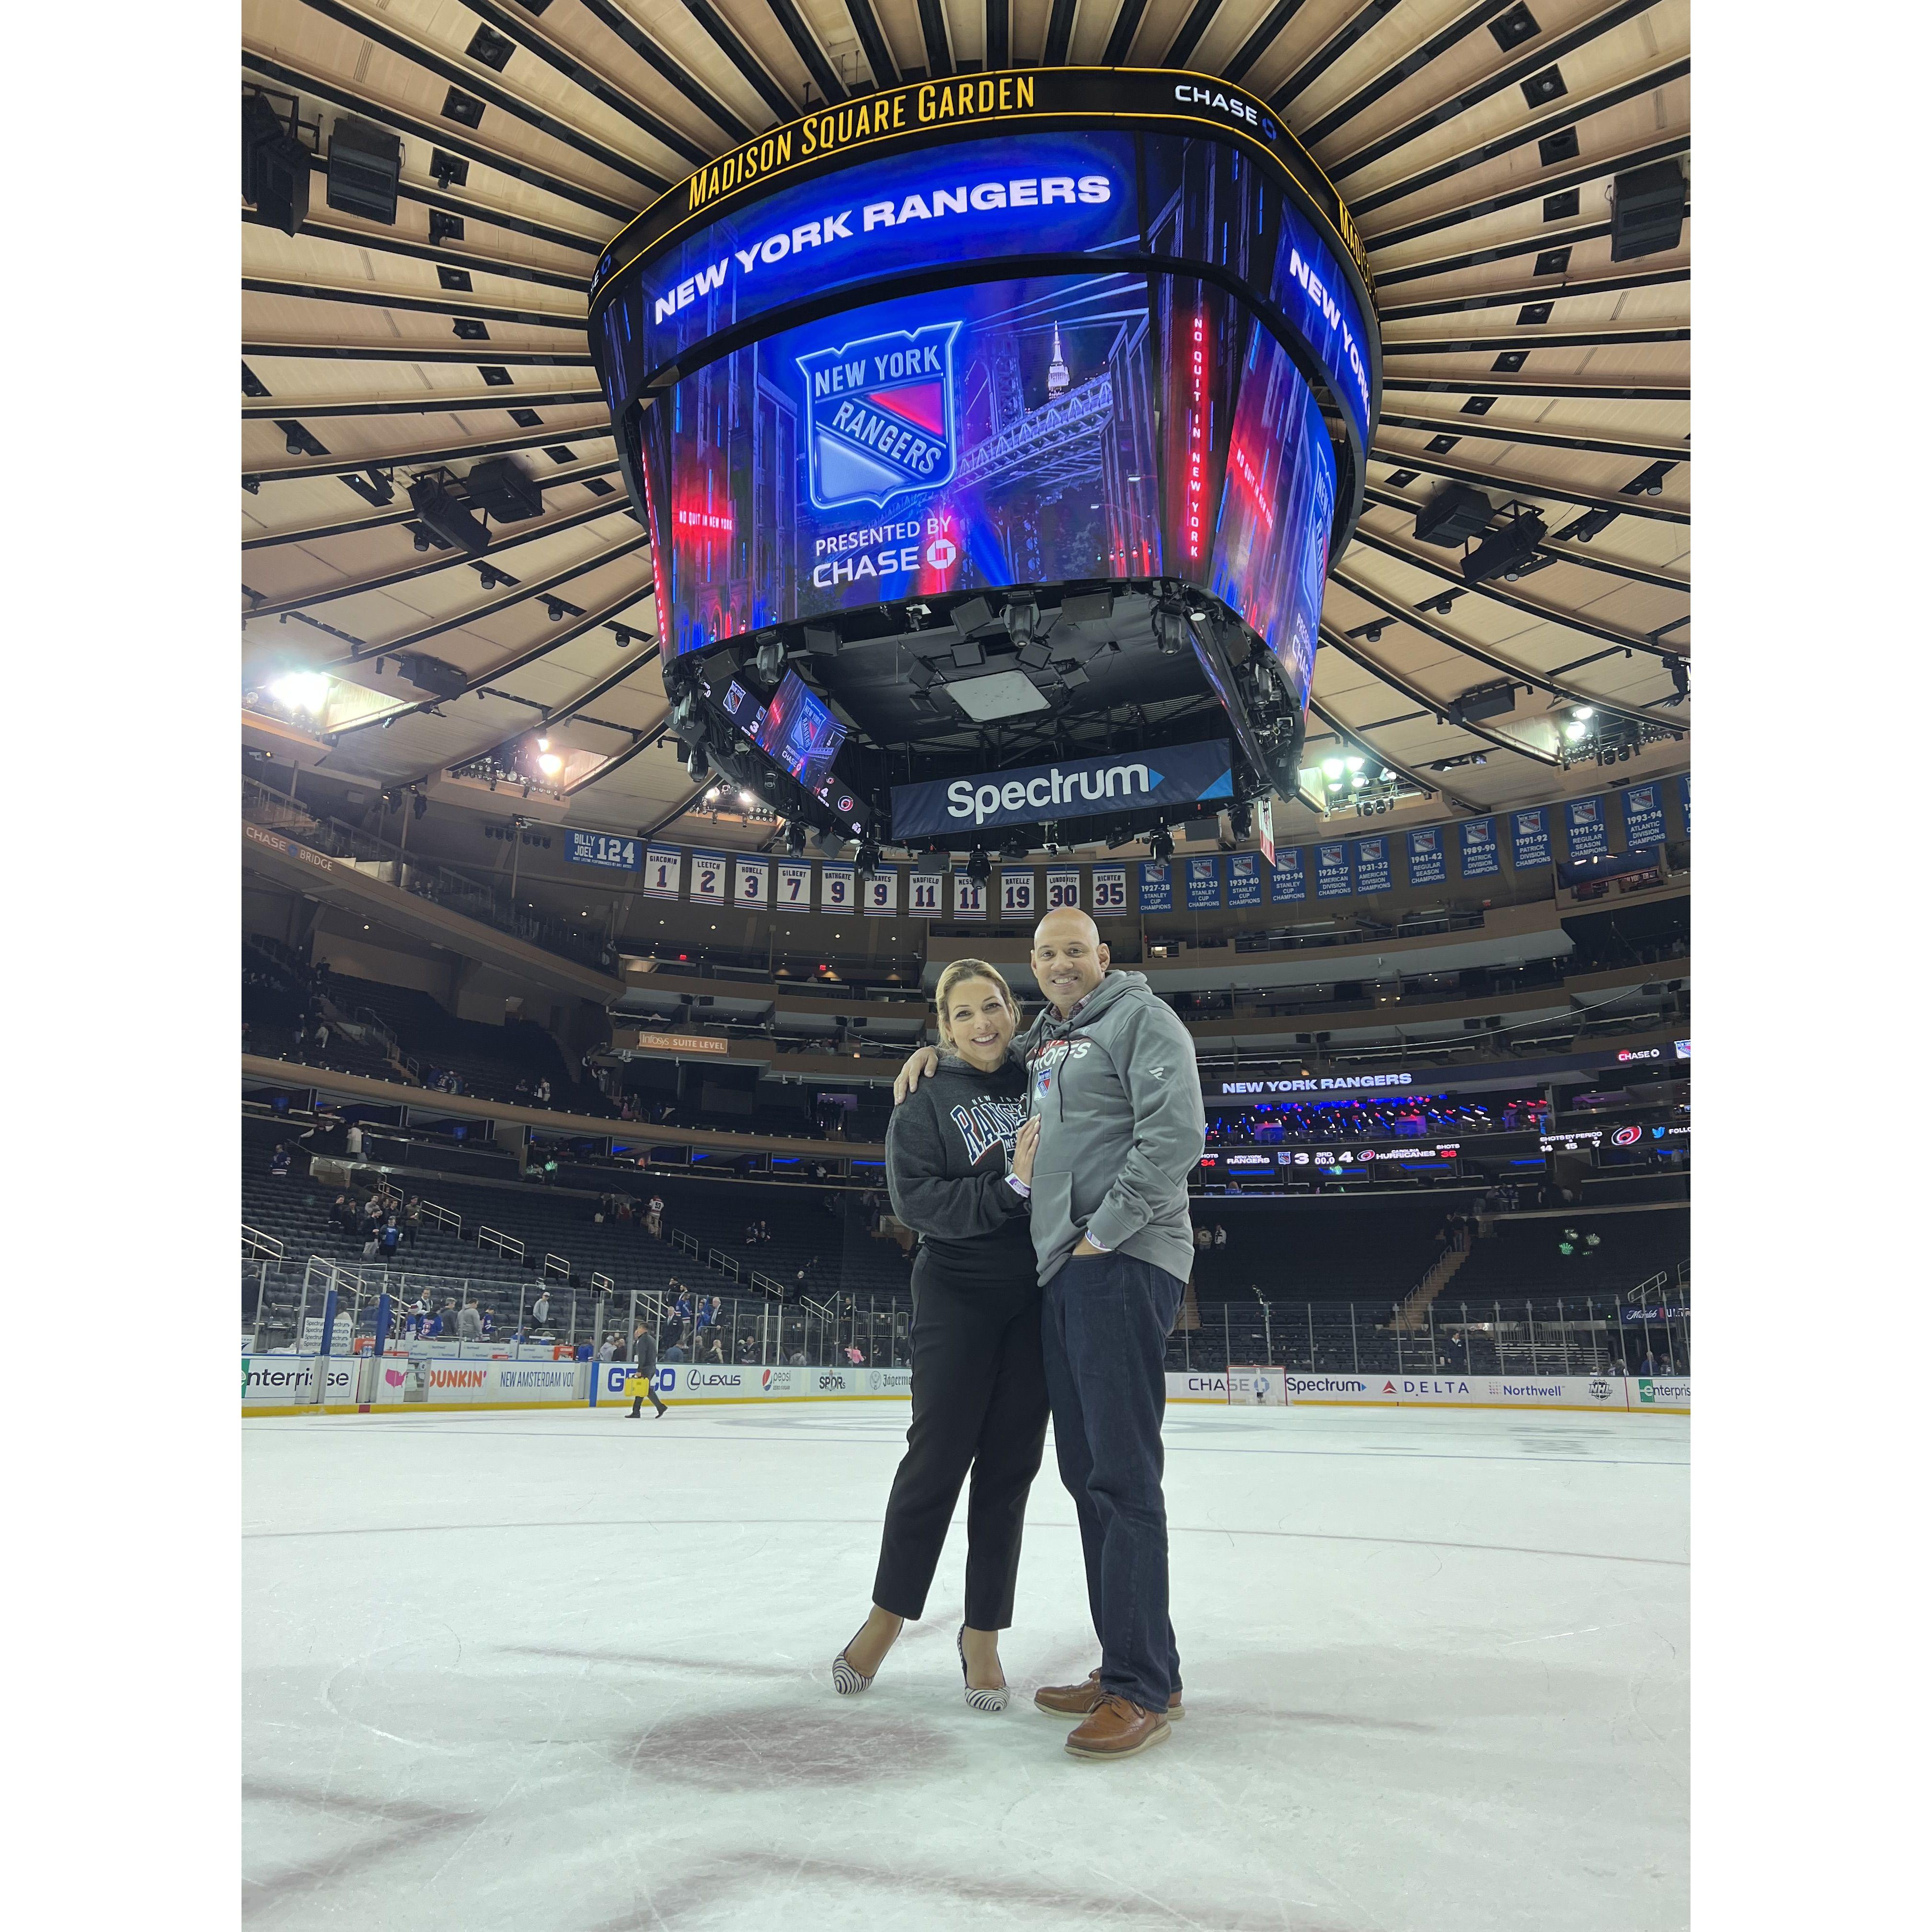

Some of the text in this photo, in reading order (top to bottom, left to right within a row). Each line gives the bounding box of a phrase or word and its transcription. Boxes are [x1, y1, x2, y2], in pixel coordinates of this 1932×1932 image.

[1174, 85, 1258, 126] CHASE
[689, 76, 1035, 211] MADISON SQUARE GARDEN
[655, 260, 729, 325] NEW
[735, 210, 854, 274] YORK
[863, 175, 1111, 232] RANGERS
[1289, 248, 1369, 405] NEW YORK
[816, 345, 942, 396] NEW YORK
[832, 401, 942, 475] RANGERS
[1191, 318, 1202, 557] NO QUIT IN NEW YORK
[679, 510, 686, 523] NO
[689, 512, 700, 526] QUIT
[710, 516, 719, 528] NEW
[721, 518, 732, 530] YORK
[816, 515, 951, 556] PRESENTED BY
[813, 546, 920, 587] CHASE
[750, 721, 759, 733] 3
[782, 750, 798, 768] CHASE
[821, 787, 828, 797] 4
[947, 763, 1150, 825] Spectrum
[1627, 810, 1662, 824] 1993-94
[1570, 824, 1604, 836] 1991-92
[1630, 821, 1660, 832] ATLANTIC
[574, 833, 596, 846] BILLY
[1516, 834, 1548, 845] 1991-92
[1573, 834, 1602, 844] REGULAR
[1633, 828, 1659, 839] DIVISION
[1576, 841, 1601, 850] SEASON
[1629, 833, 1666, 847] CHAMPIONS
[246, 826, 333, 871] CHASE BRIDGE
[574, 845, 593, 858] JOEL
[597, 837, 634, 864] 124
[1463, 843, 1495, 855] 1989-90
[1519, 844, 1544, 854] PATRICK
[1571, 846, 1607, 858] CHAMPIONS
[650, 855, 677, 865] GIACOMIN
[1411, 852, 1442, 863] 1941-42
[1468, 853, 1492, 862] PATRICK
[1516, 856, 1551, 867] CHAMPIONS
[1520, 851, 1545, 860] DIVISION
[697, 861, 721, 870] LEETCH
[742, 866, 762, 875] HOWELL
[1358, 862, 1388, 872] 1931-32
[1414, 862, 1441, 871] REGULAR
[1464, 865, 1498, 875] CHAMPIONS
[1468, 860, 1493, 869] DIVISION
[656, 865, 667, 888] 1
[825, 873, 851, 881] BATHGATE
[1273, 872, 1303, 882] 1993-94
[1318, 867, 1349, 876] 1926-27
[1359, 871, 1388, 880] AMERICAN
[1416, 868, 1439, 877] SEASON
[701, 870, 715, 893] 2
[1189, 881, 1218, 889] 1932-33
[1230, 877, 1259, 886] 1939-40
[1320, 876, 1348, 884] AMERICAN
[1362, 877, 1386, 886] DIVISION
[1411, 874, 1445, 884] CHAMPIONS
[744, 875, 759, 898] 3
[787, 878, 801, 901] 7
[831, 881, 844, 903] 9
[1141, 884, 1170, 892] 1927-28
[1319, 887, 1351, 896] CHAMPIONS
[1358, 883, 1391, 892] CHAMPIONS
[874, 884, 887, 906] 9
[915, 885, 935, 907] 11
[960, 887, 979, 909] 11
[1006, 886, 1030, 908] 19
[1050, 885, 1077, 907] 30
[1095, 883, 1124, 906] 35
[642, 1034, 724, 1049] Infosys SUITE LEVEL
[1618, 1050, 1650, 1061] CHASE
[1222, 1073, 1413, 1094] NEW YORK RANGERS
[972, 1095, 991, 1104] NEW
[950, 1103, 1027, 1166] RANGE
[1540, 1134, 1564, 1142] SHOTS
[1576, 1131, 1603, 1139] PERIOD
[1540, 1144, 1553, 1152] 14
[1592, 1139, 1601, 1148] 7
[1294, 1152, 1310, 1164] 3
[1338, 1151, 1354, 1162] 4
[1376, 1150, 1436, 1160] HURRICANES
[500, 1371, 516, 1387] NEW
[518, 1371, 561, 1387] AMSTERDAM
[702, 1374, 741, 1386] LEXUS
[773, 1370, 791, 1383] pepsi
[1188, 1378, 1250, 1392] CHASE
[1287, 1377, 1361, 1394] Spectrum
[1404, 1381, 1470, 1393] DELTA
[1503, 1384, 1562, 1396] Northwell
[1588, 1384, 1613, 1393] NHL
